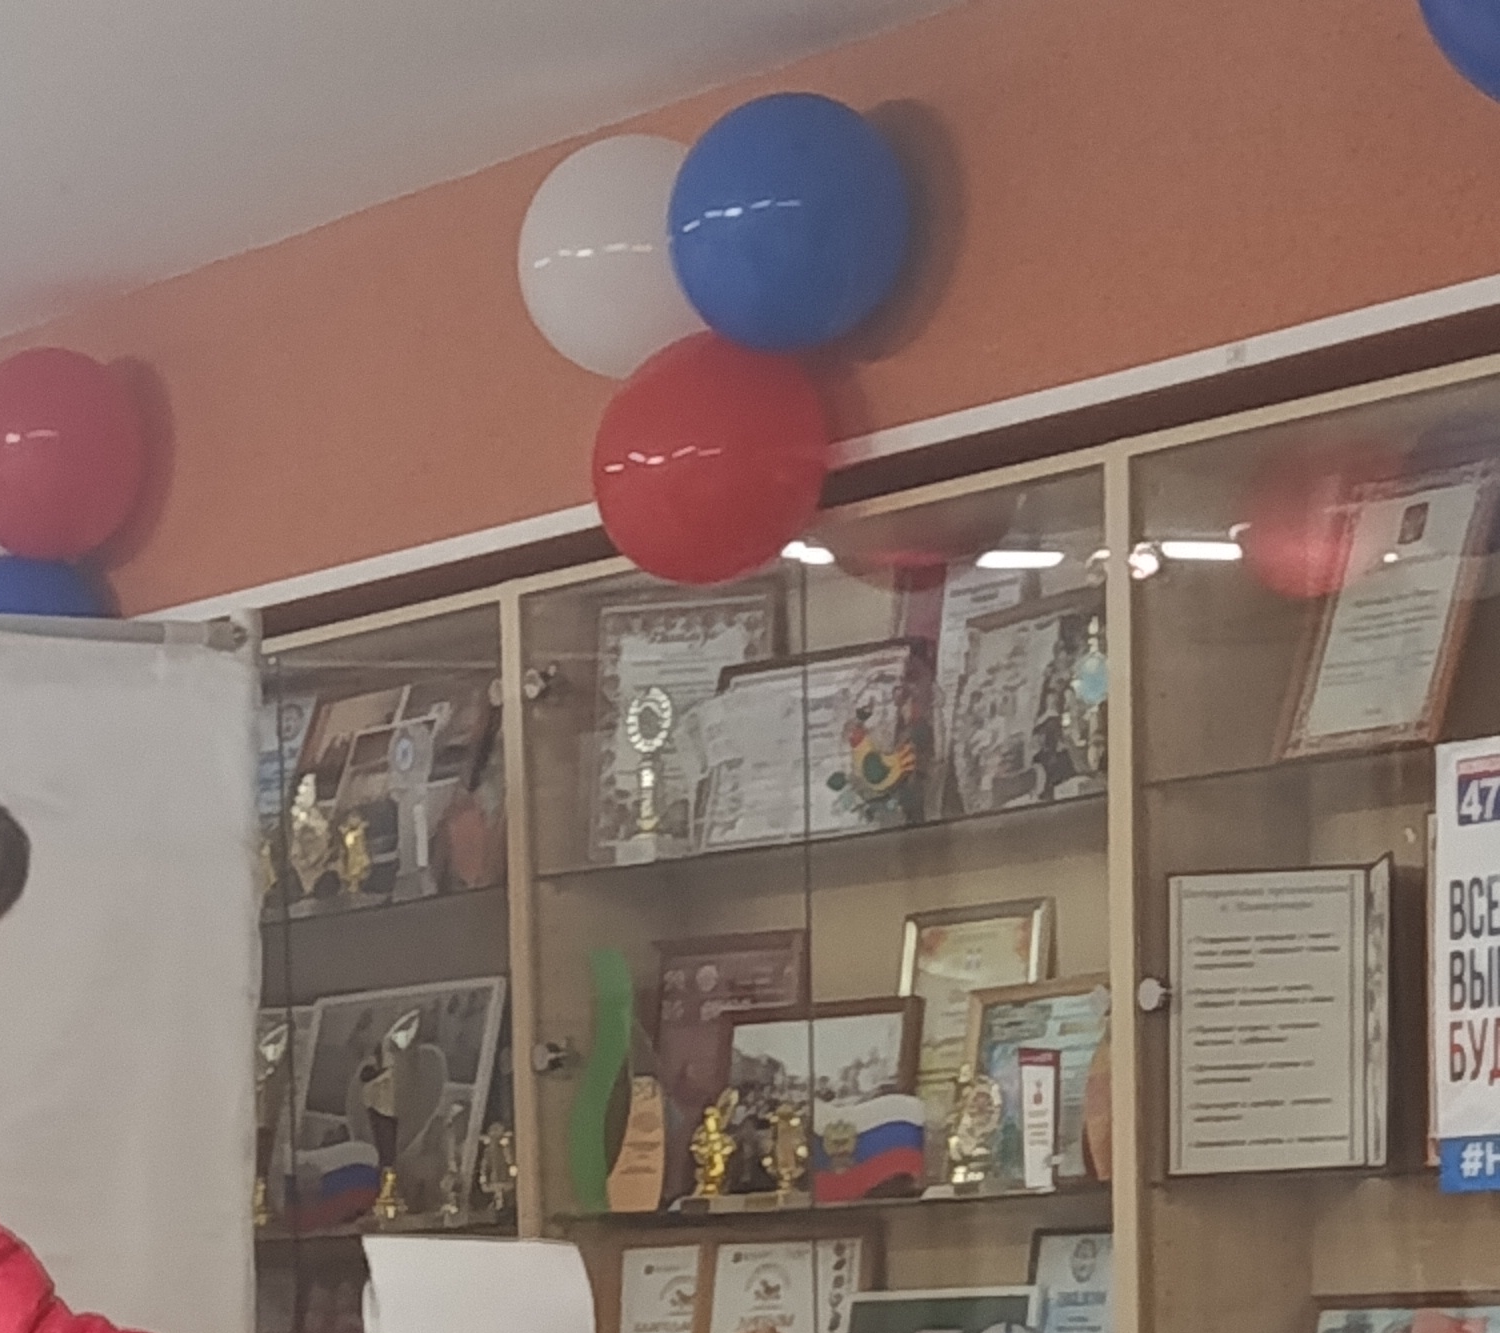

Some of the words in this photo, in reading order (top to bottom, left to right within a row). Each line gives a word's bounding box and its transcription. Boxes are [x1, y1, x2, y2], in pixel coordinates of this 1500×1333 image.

[1460, 777, 1500, 822] 47
[1449, 875, 1500, 940] ВСЕ
[1449, 946, 1500, 1011] ВЫ
